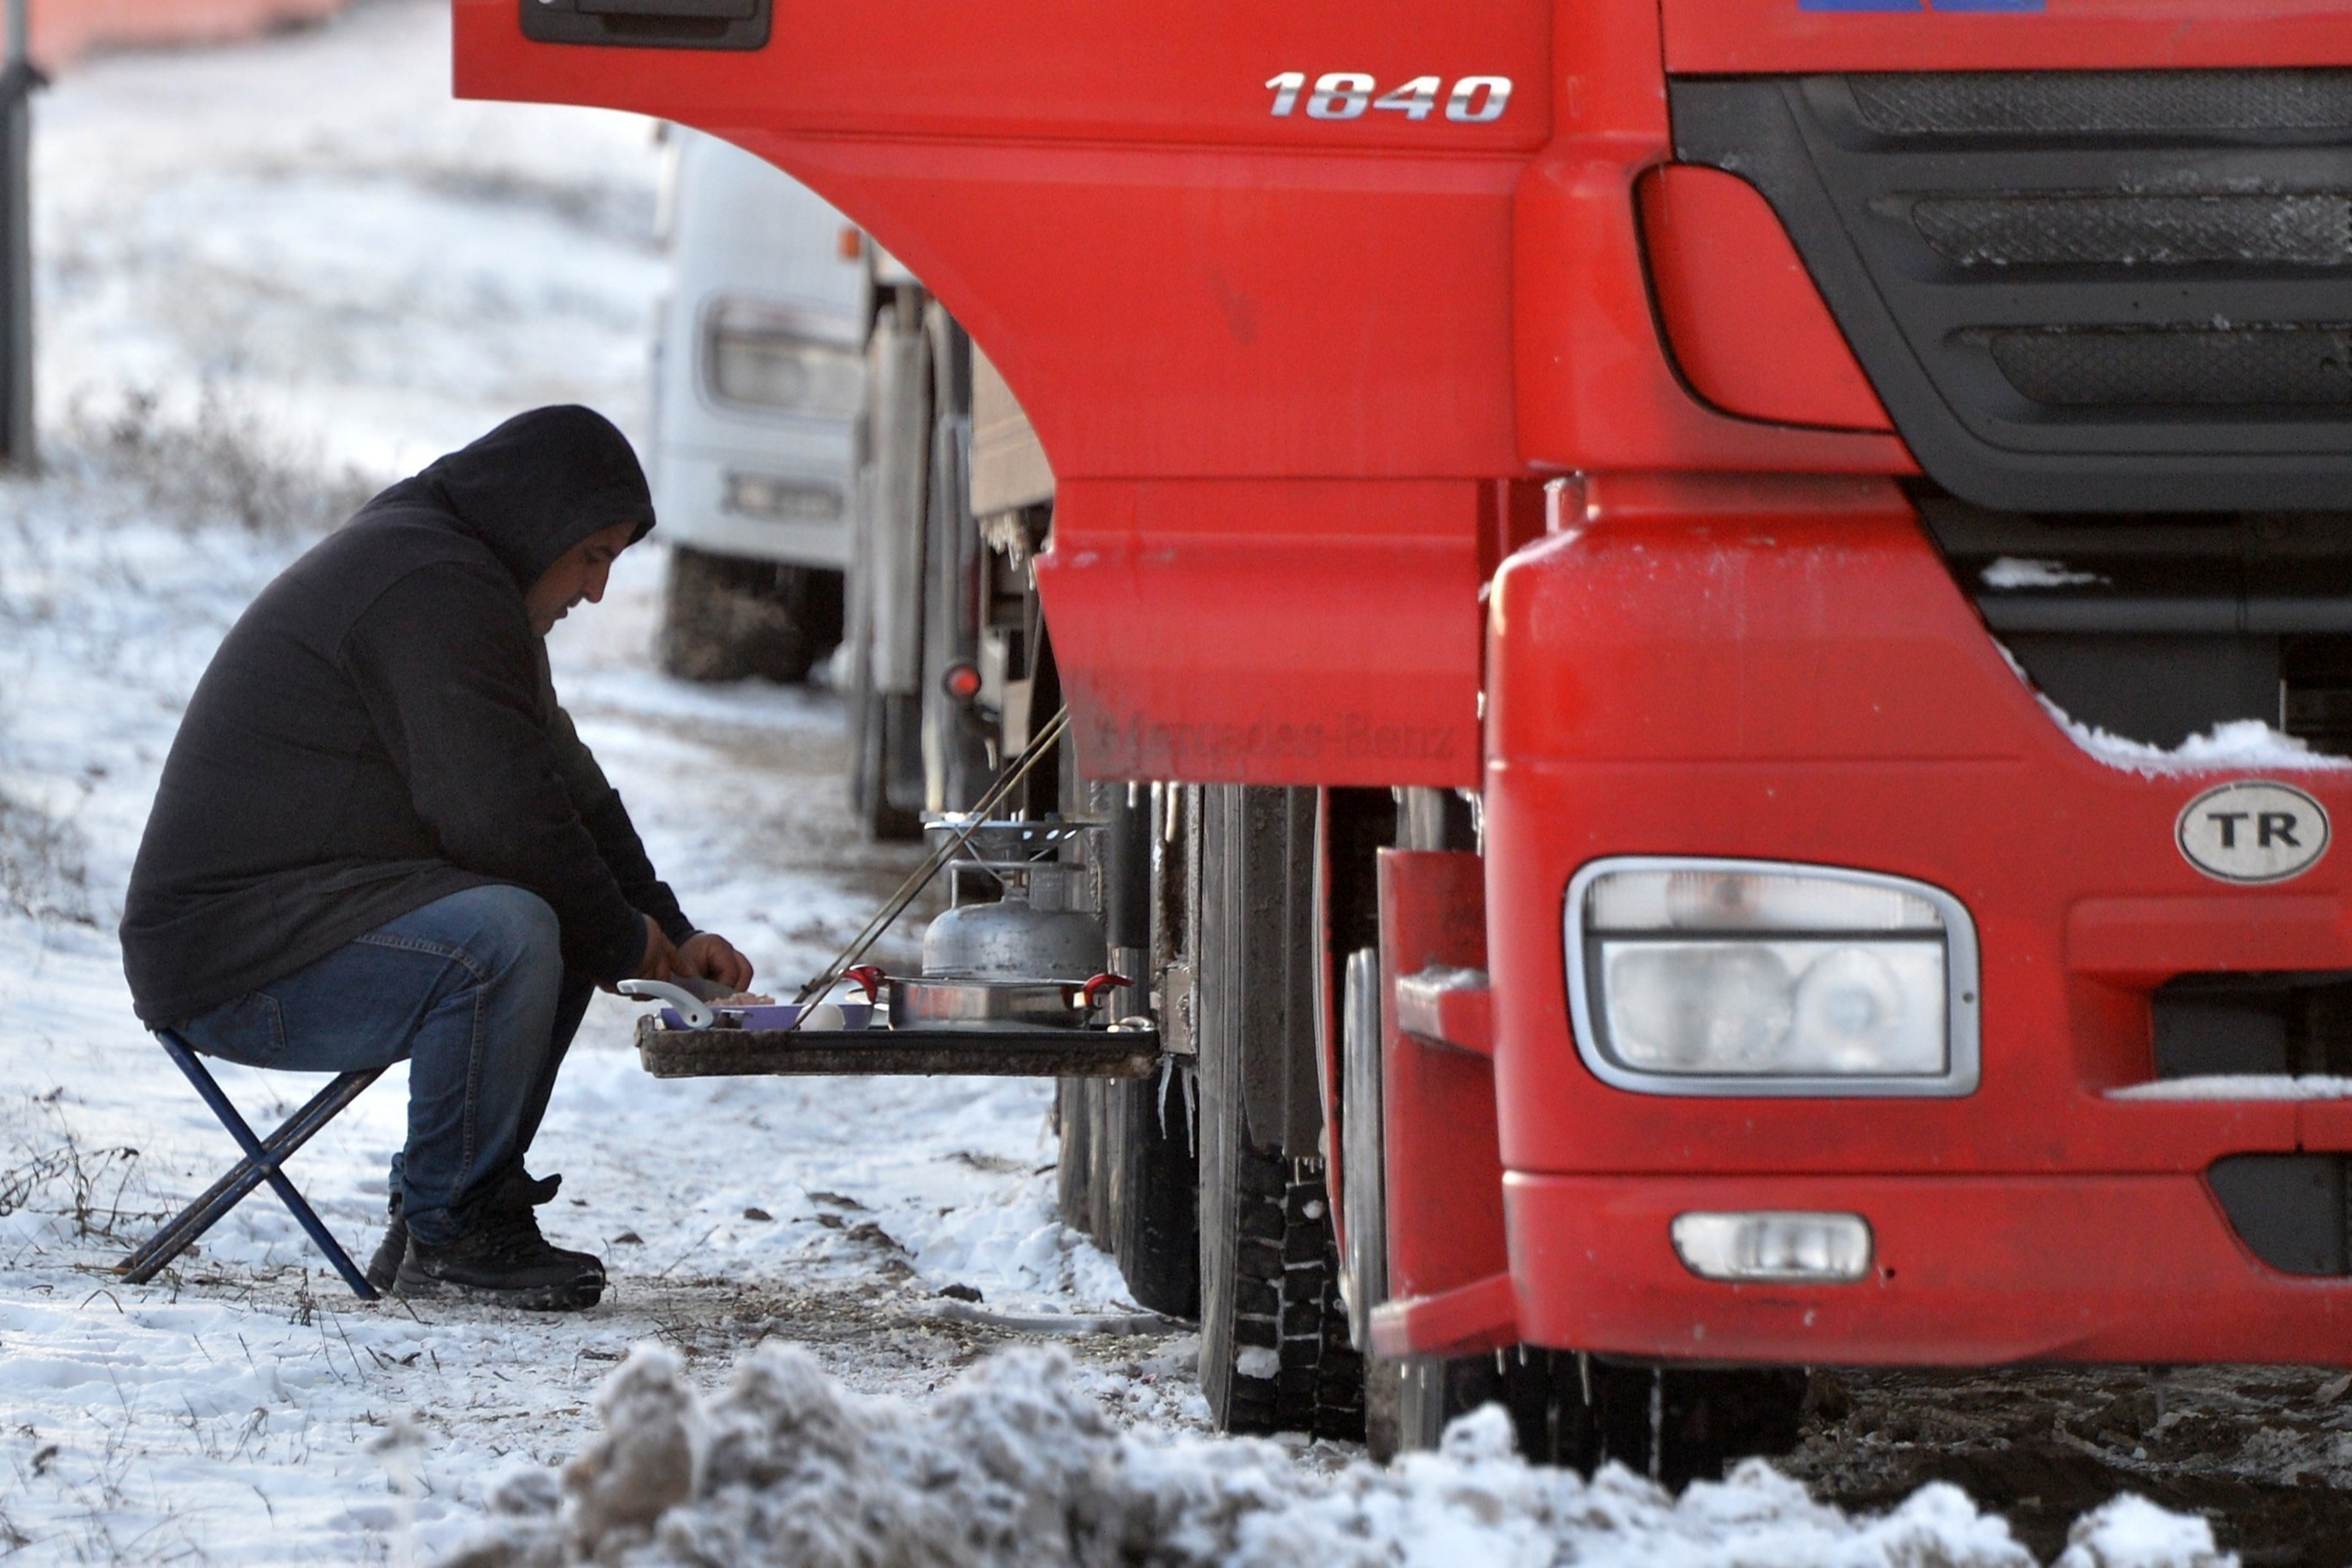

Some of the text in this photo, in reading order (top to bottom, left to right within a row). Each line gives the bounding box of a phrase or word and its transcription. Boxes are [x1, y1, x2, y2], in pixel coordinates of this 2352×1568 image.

[1265, 72, 1513, 122] 1840
[1096, 709, 1456, 761] Mercedes-Benz
[2207, 813, 2302, 848] TR
